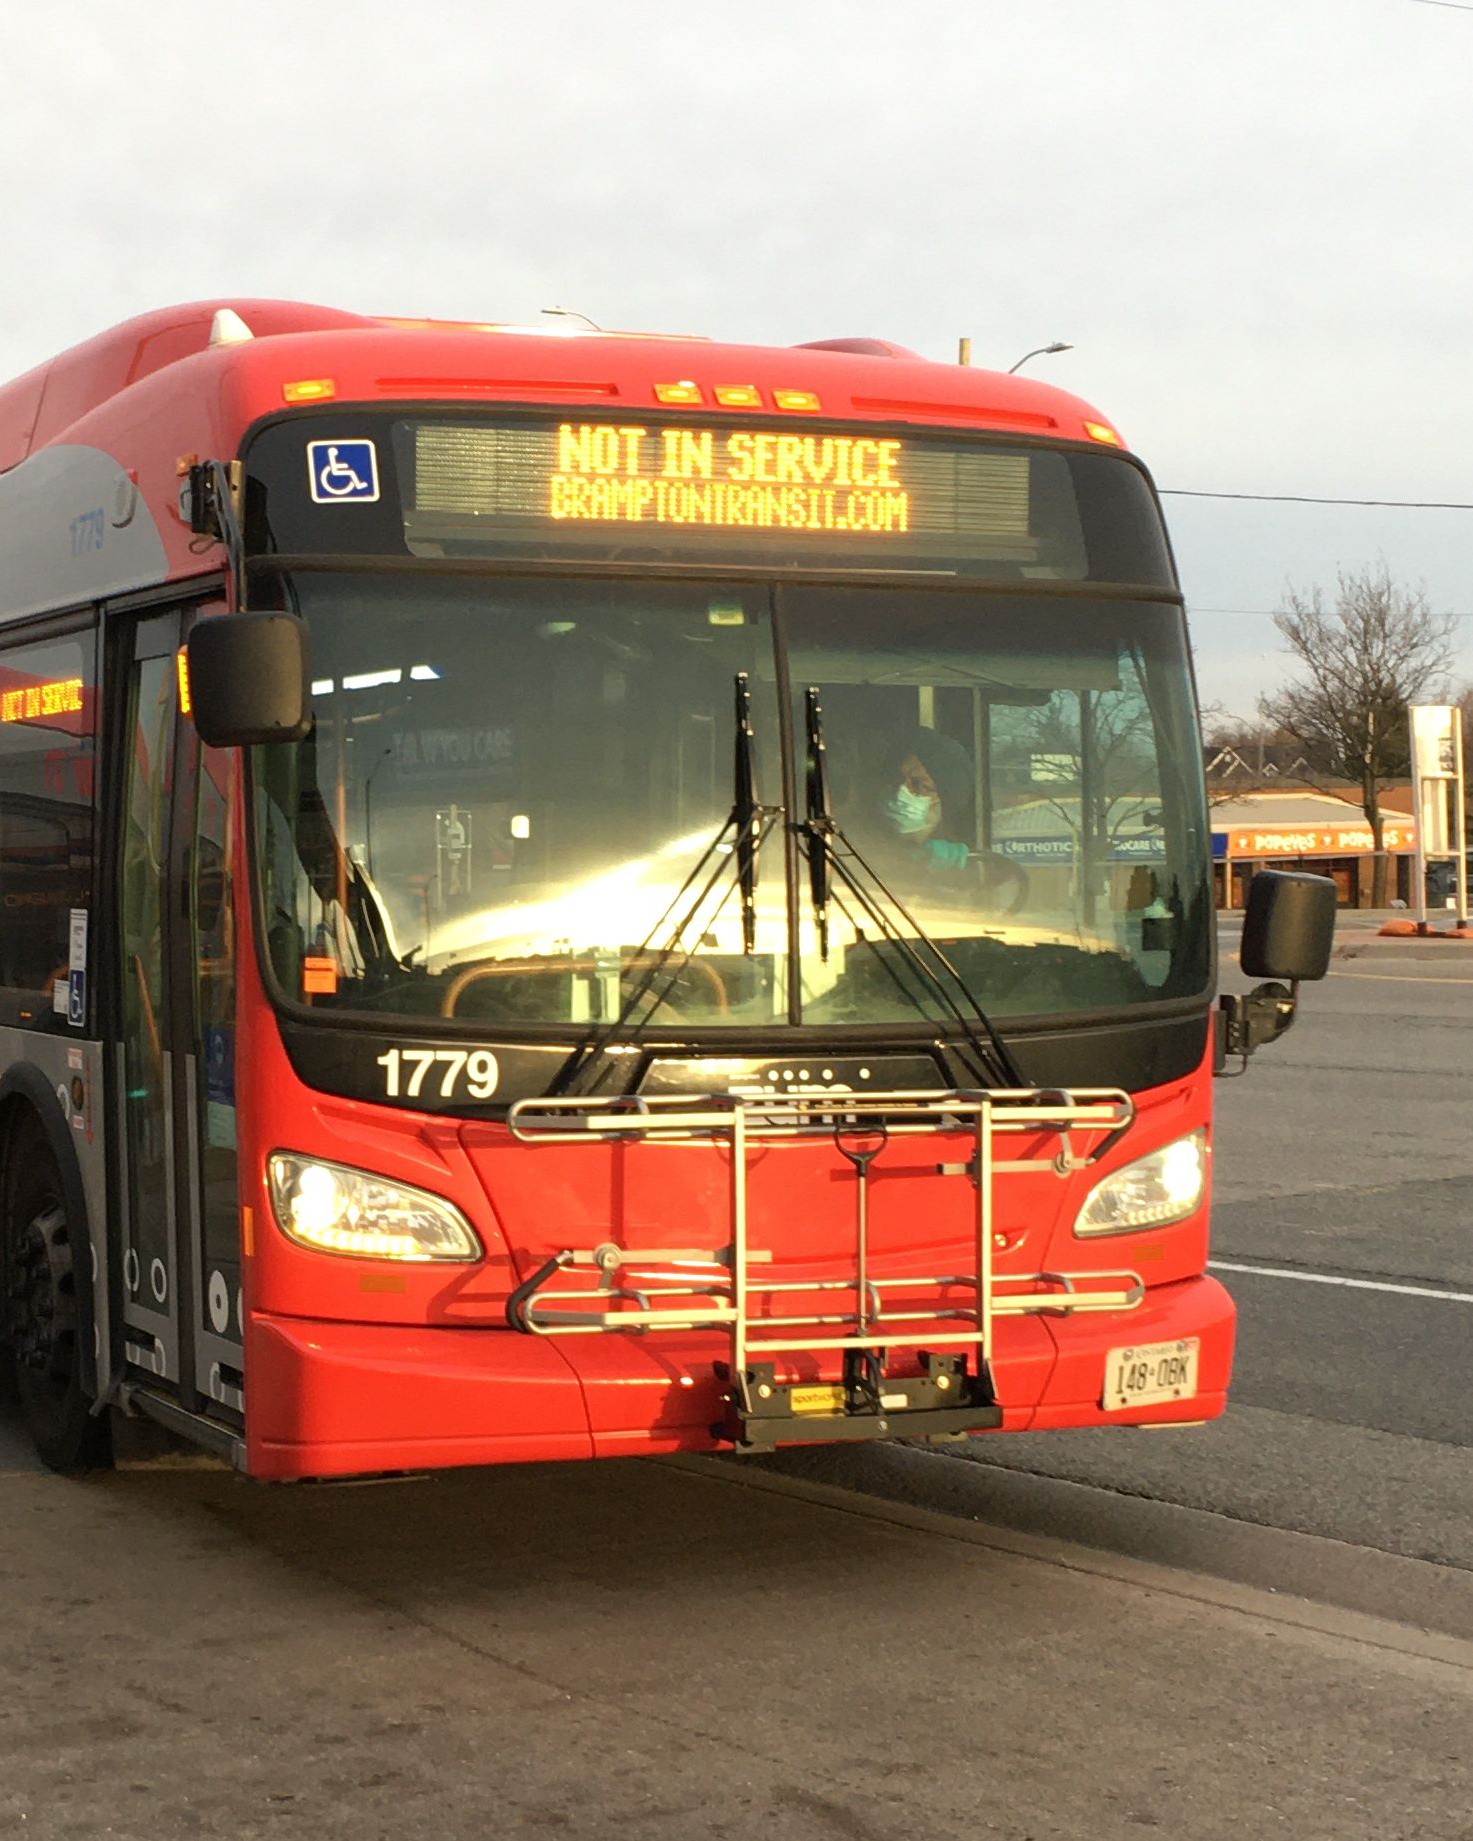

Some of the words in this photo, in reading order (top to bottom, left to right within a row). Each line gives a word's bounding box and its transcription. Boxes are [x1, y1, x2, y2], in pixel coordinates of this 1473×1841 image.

[558, 423, 648, 476] NOT
[661, 429, 714, 480] IN
[726, 433, 902, 488] SERVICE
[550, 475, 909, 533] BRAMPTONTRANSIT.COM
[376, 1048, 500, 1099] 1779
